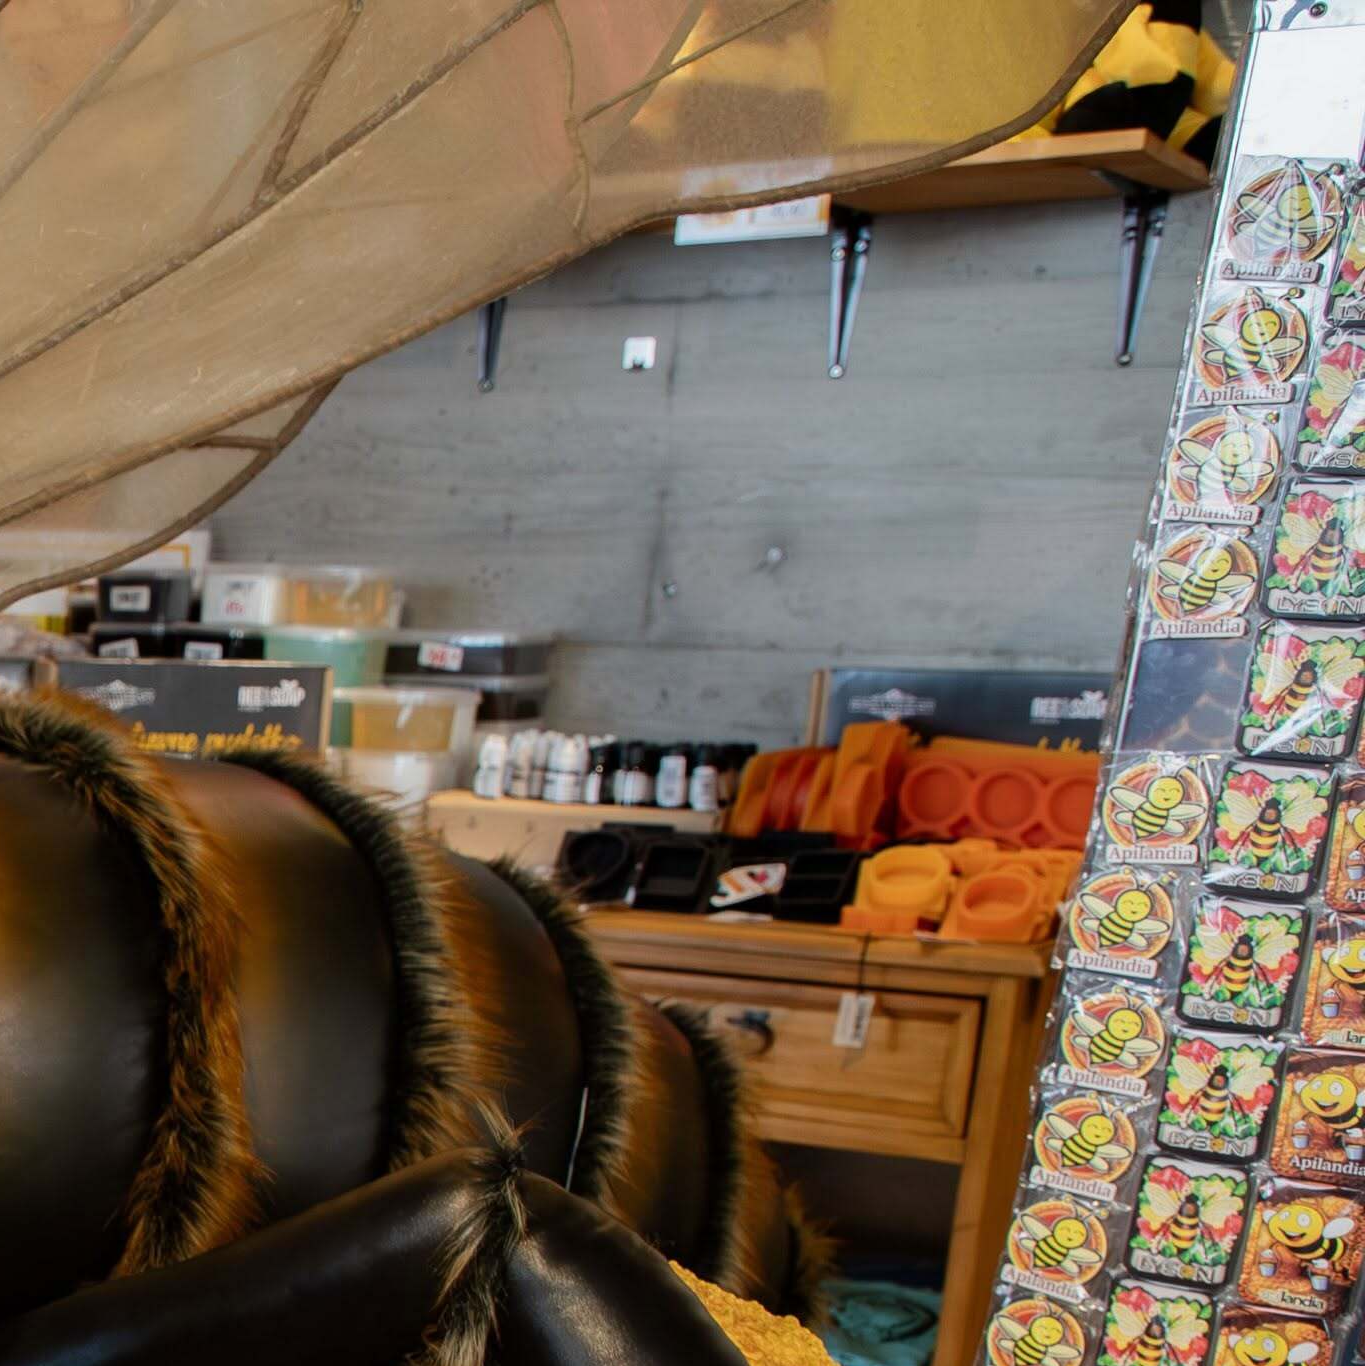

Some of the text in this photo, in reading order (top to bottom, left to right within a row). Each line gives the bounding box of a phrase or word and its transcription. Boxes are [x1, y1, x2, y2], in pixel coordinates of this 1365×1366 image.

[1154, 618, 1242, 636] Apilandia
[1108, 846, 1193, 862] Apilandia
[1070, 951, 1152, 976] Apilandia
[1191, 1002, 1273, 1026] LYSON
[1060, 1066, 1143, 1095] Apilandia
[1168, 1131, 1248, 1156] LYSON
[1034, 1167, 1113, 1198] Apilandia
[1135, 1252, 1215, 1281] LYSON
[1005, 1268, 1079, 1300] Apilandia
